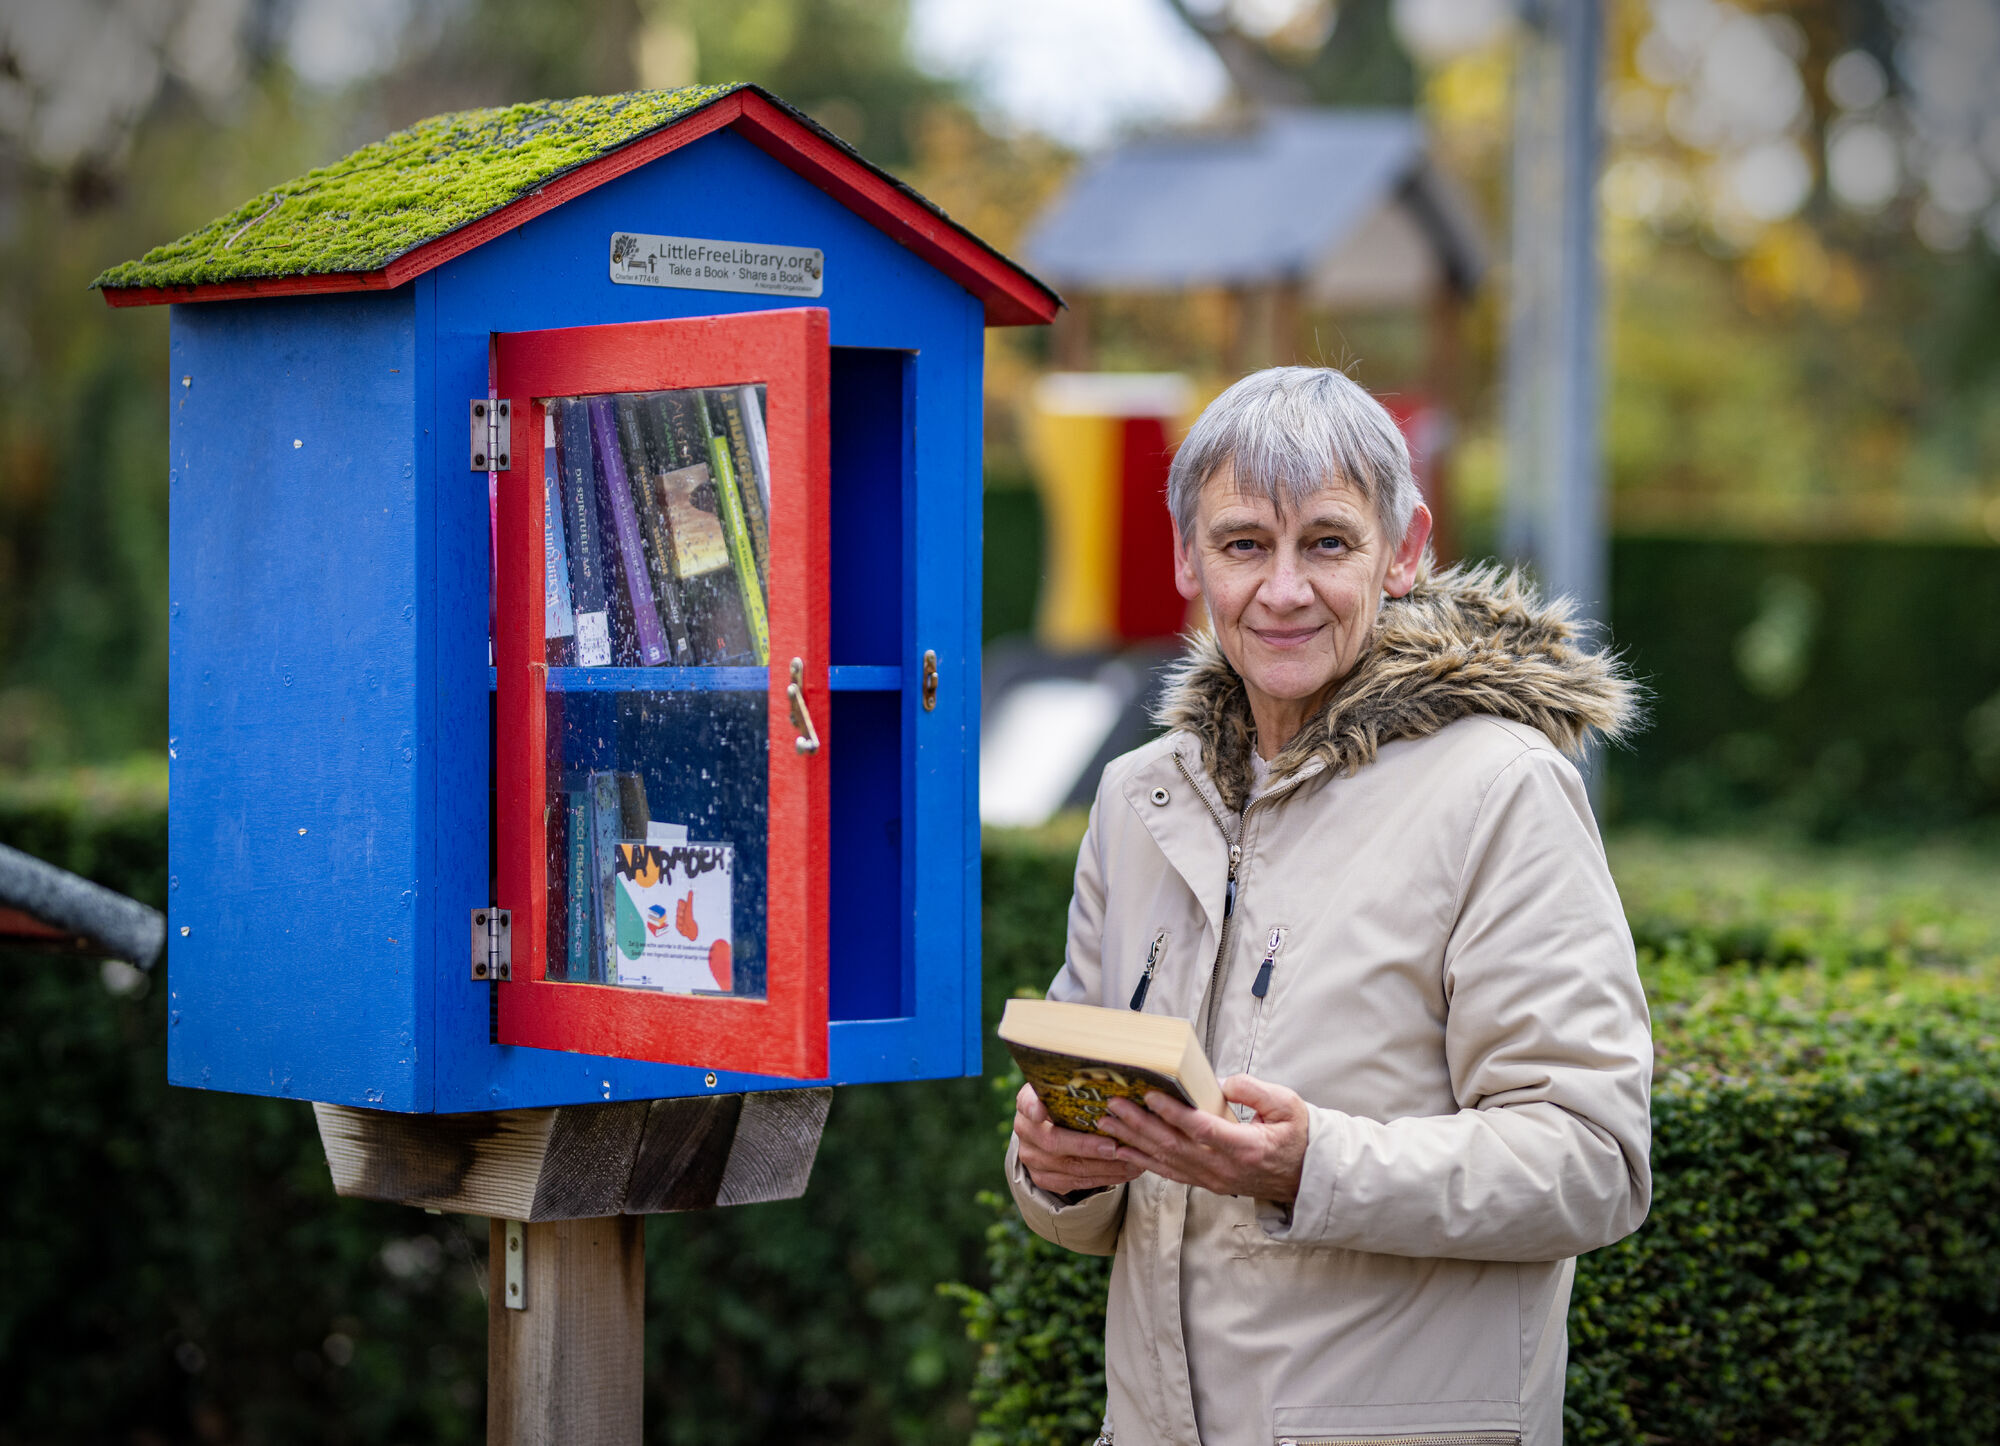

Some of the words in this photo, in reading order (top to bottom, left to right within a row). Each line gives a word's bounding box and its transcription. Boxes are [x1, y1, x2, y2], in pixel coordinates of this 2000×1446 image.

[659, 244, 813, 271] LittleFreeLibrary.org
[669, 263, 692, 276] Take
[695, 268, 700, 277] a
[704, 266, 728, 279] Book
[739, 268, 767, 281] Share
[770, 272, 776, 281] a
[779, 270, 803, 283] Book
[574, 467, 582, 483] DE
[574, 486, 589, 554] SPIRITUELE
[581, 556, 591, 578] AAP
[575, 805, 585, 840] NICCI
[574, 844, 584, 898] FRENCH
